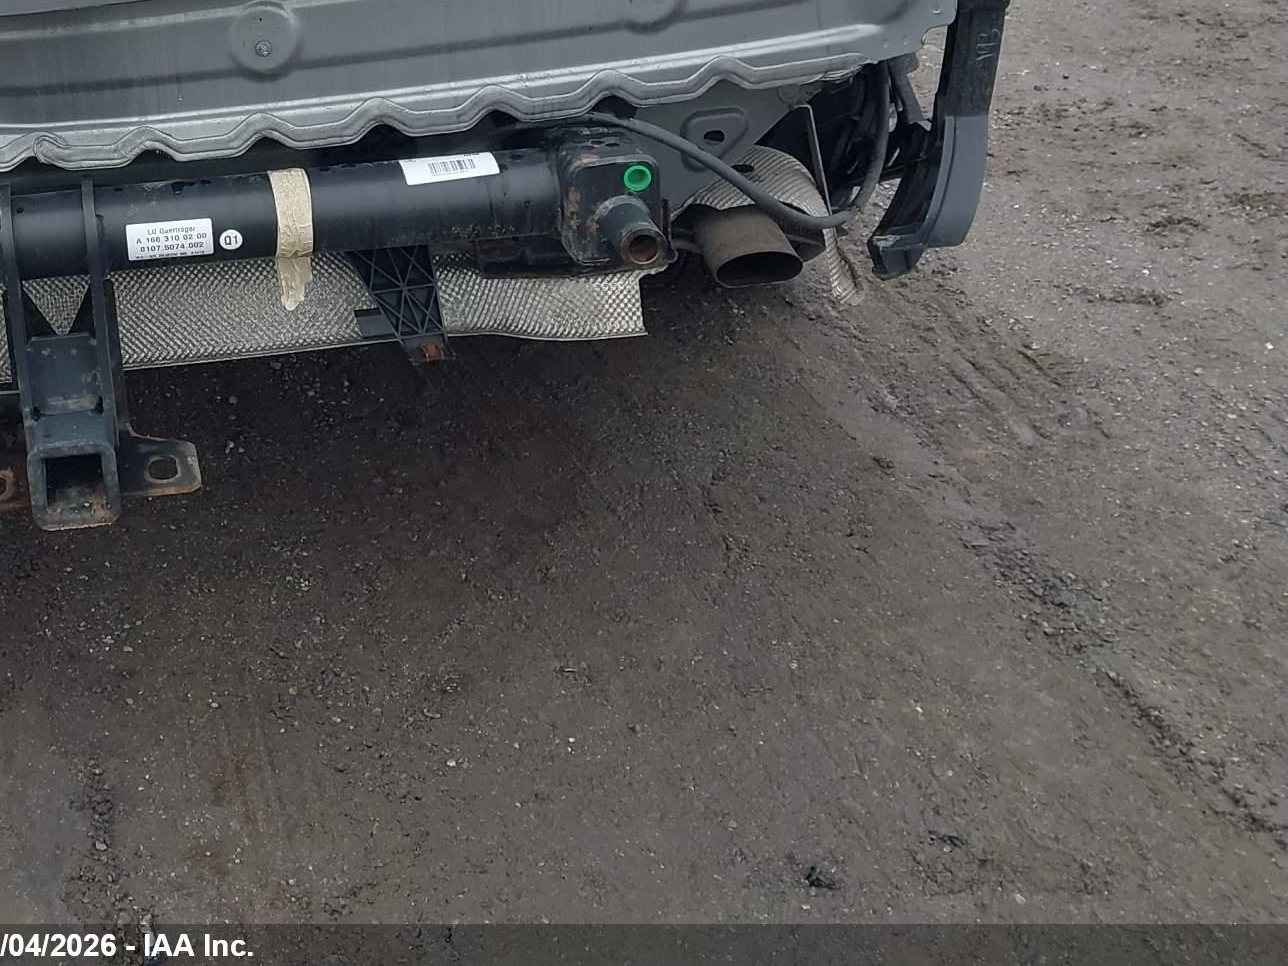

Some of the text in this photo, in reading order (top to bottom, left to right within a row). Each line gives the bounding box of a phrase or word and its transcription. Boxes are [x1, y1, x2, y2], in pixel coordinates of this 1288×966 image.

[136, 237, 142, 245] A
[164, 235, 180, 243] 310
[183, 233, 194, 241] 02
[196, 232, 207, 240] 00
[223, 235, 239, 246] Q1
